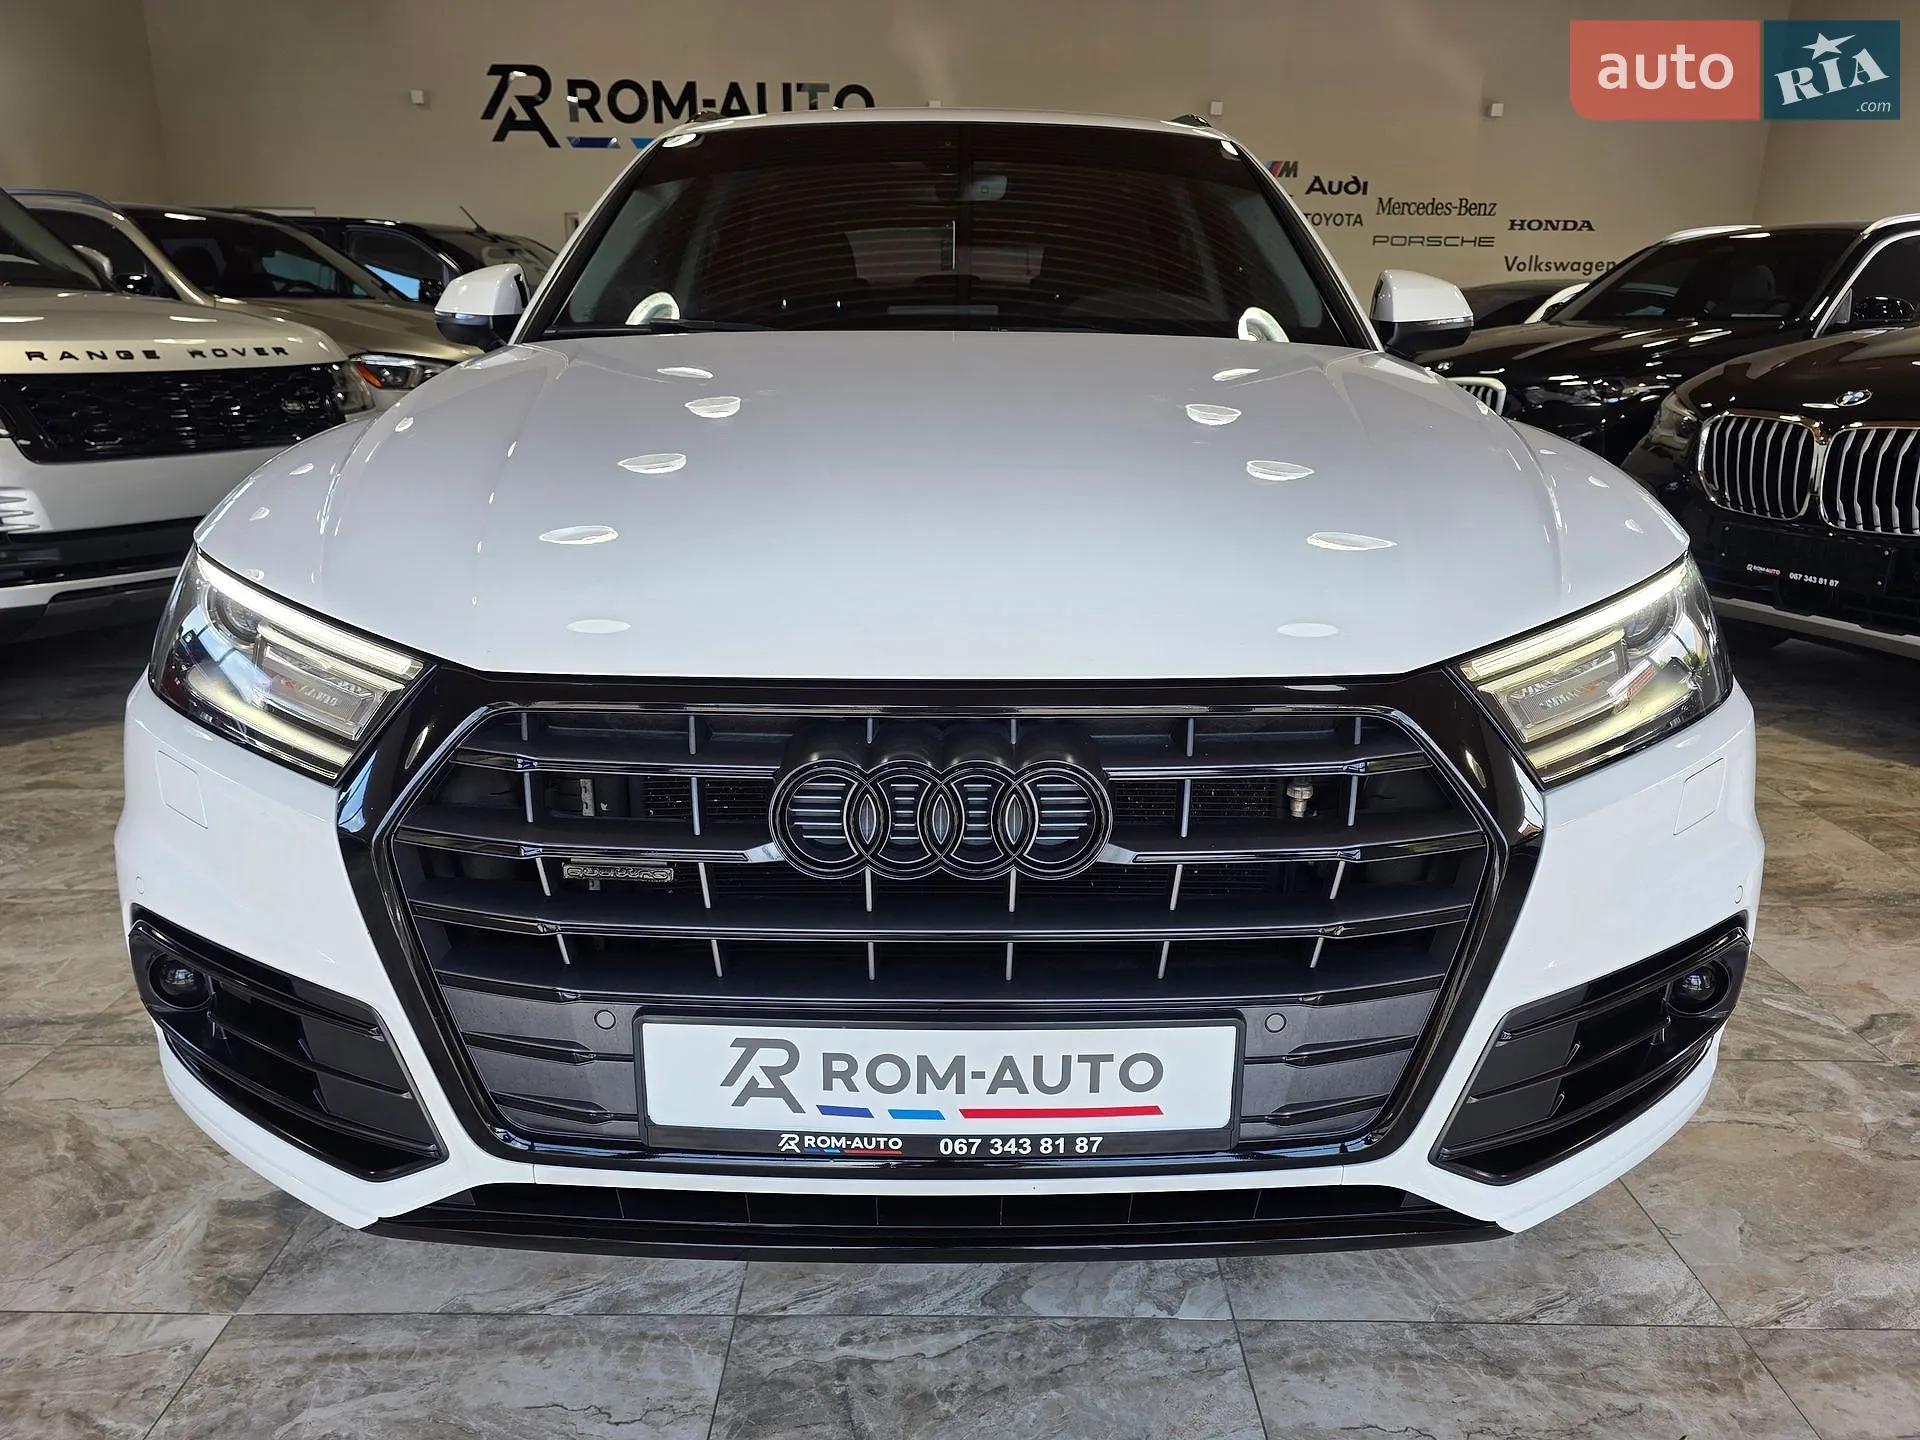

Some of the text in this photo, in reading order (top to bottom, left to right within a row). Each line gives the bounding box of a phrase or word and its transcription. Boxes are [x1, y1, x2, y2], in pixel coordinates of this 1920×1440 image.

[566, 79, 875, 124] ROM-AUTO
[1305, 175, 1368, 196] Audi
[1376, 197, 1497, 217] Mercedes-Benz
[1508, 219, 1596, 232] HONDA
[1372, 235, 1495, 248] PORSCHE
[25, 347, 289, 361] RANGE ROVER
[822, 1052, 1164, 1095] ROM-AUTO
[804, 1135, 903, 1150] ROM-AUTO
[939, 1136, 1104, 1155] 067 343 81 87
